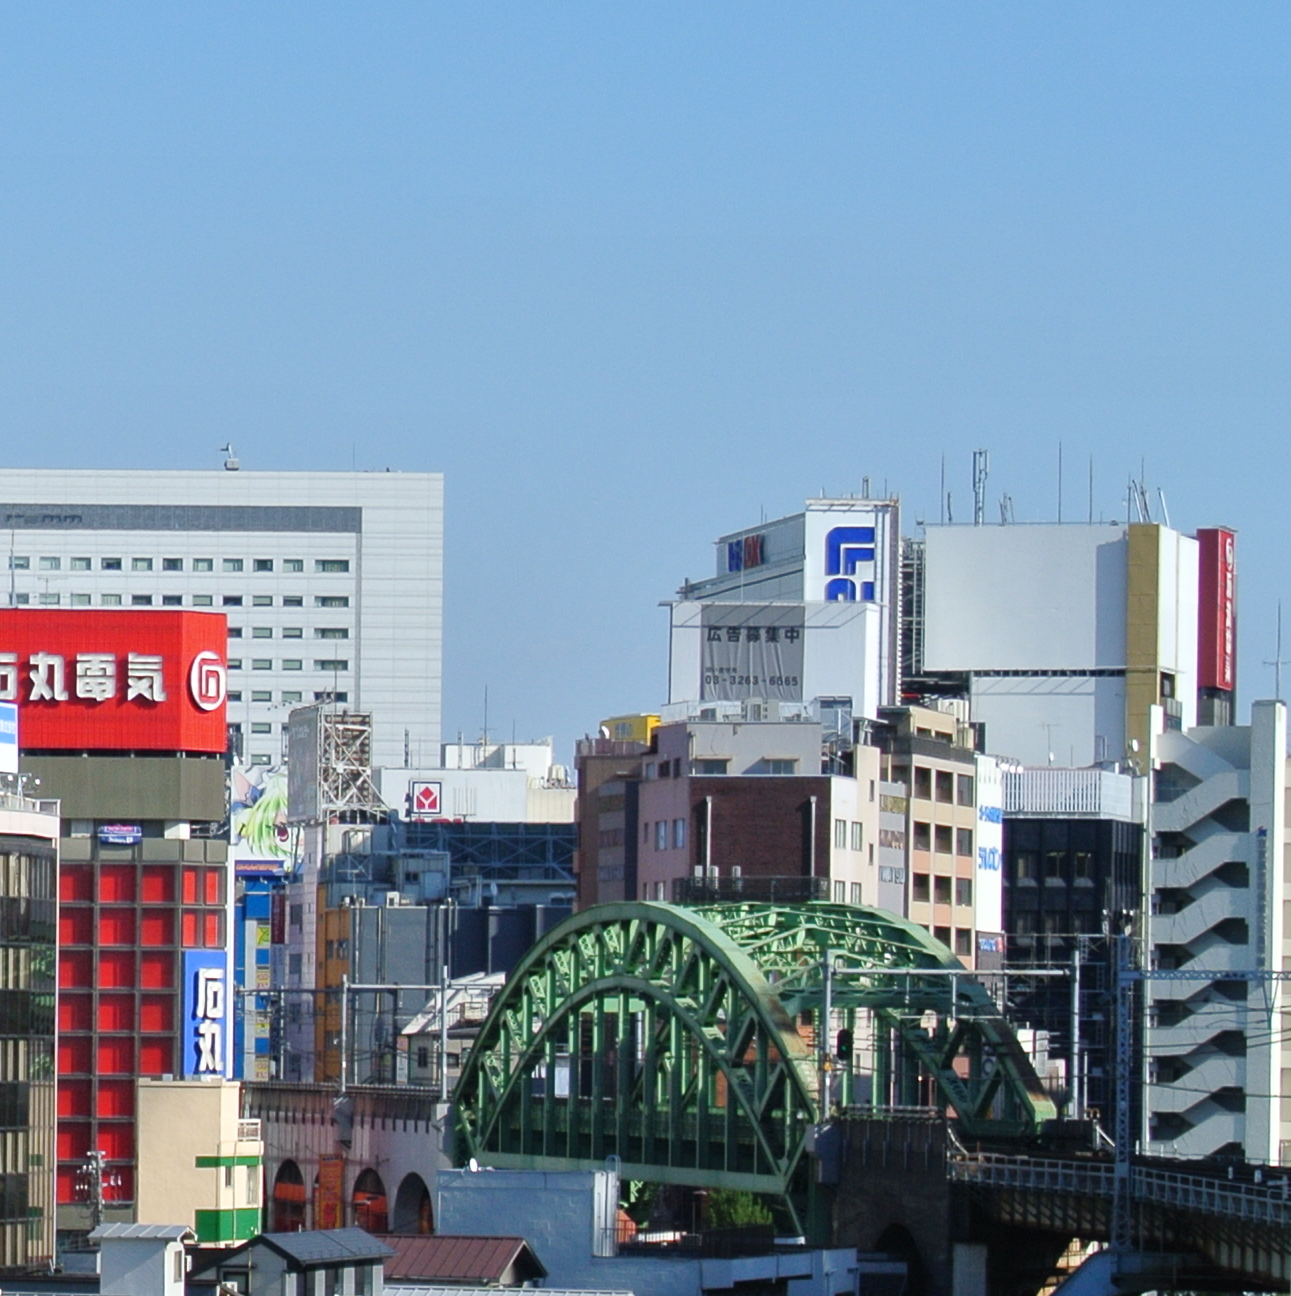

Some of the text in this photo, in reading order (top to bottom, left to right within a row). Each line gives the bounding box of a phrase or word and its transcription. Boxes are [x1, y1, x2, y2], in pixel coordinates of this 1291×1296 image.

[707, 625, 800, 644] 広告募集中
